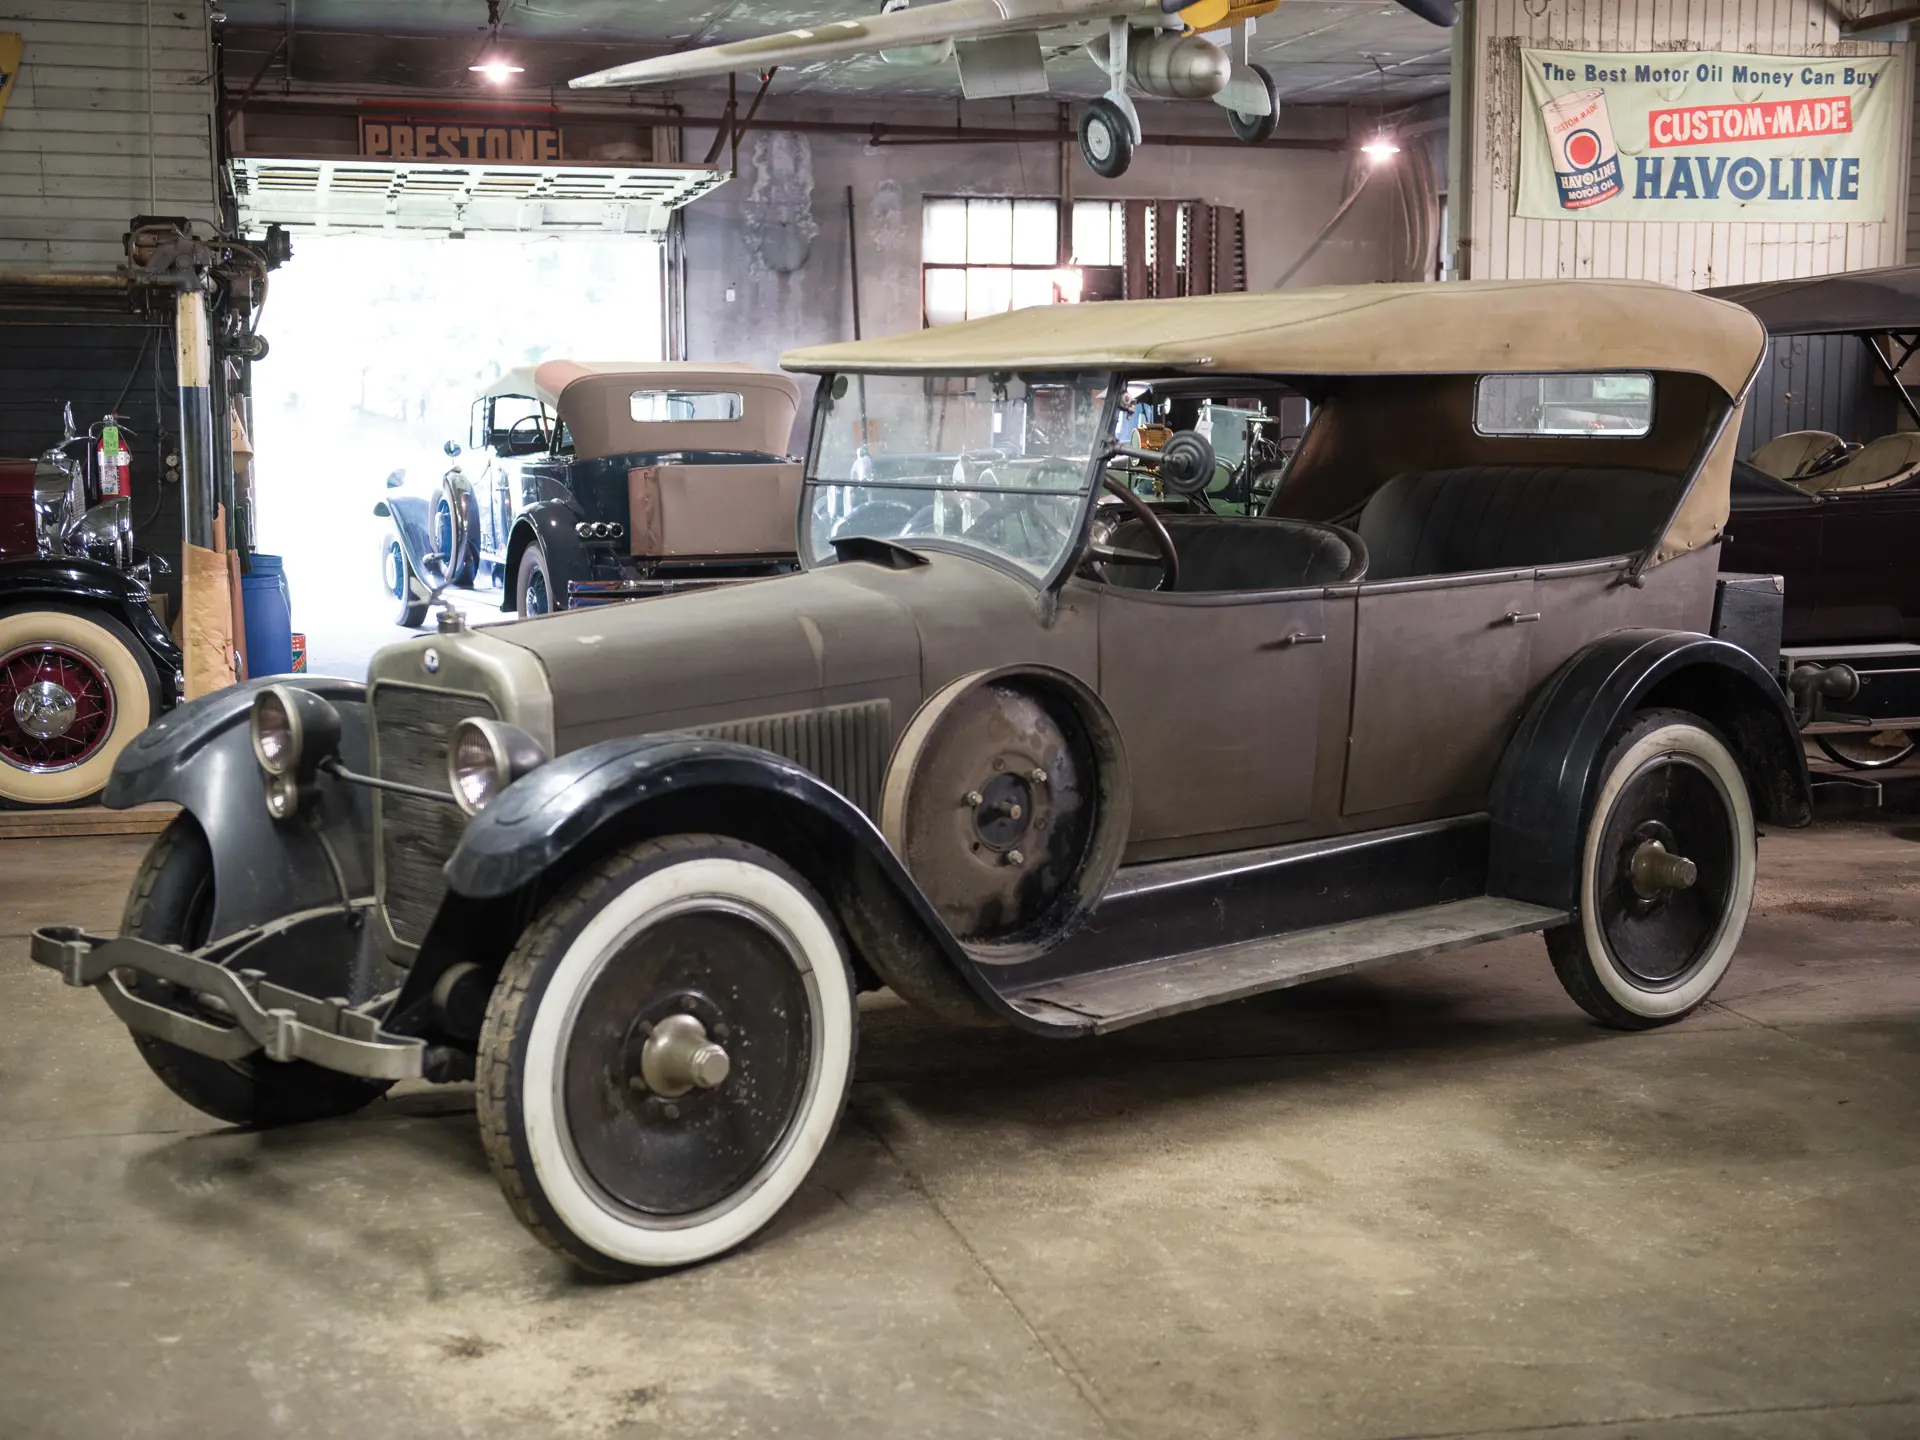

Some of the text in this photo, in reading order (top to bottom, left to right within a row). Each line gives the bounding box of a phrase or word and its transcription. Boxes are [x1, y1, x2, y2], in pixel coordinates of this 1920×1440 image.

[1542, 63, 1880, 88] The Best Motor Oil Money Can Buy
[1654, 101, 1848, 144] CUSTOM-MADE
[364, 124, 558, 161] PRESTONE
[1560, 161, 1617, 189] HAVOLINE
[1568, 184, 1600, 200] MOTOR
[1600, 179, 1615, 191] OIL
[1632, 156, 1860, 201] HAVOLINE
